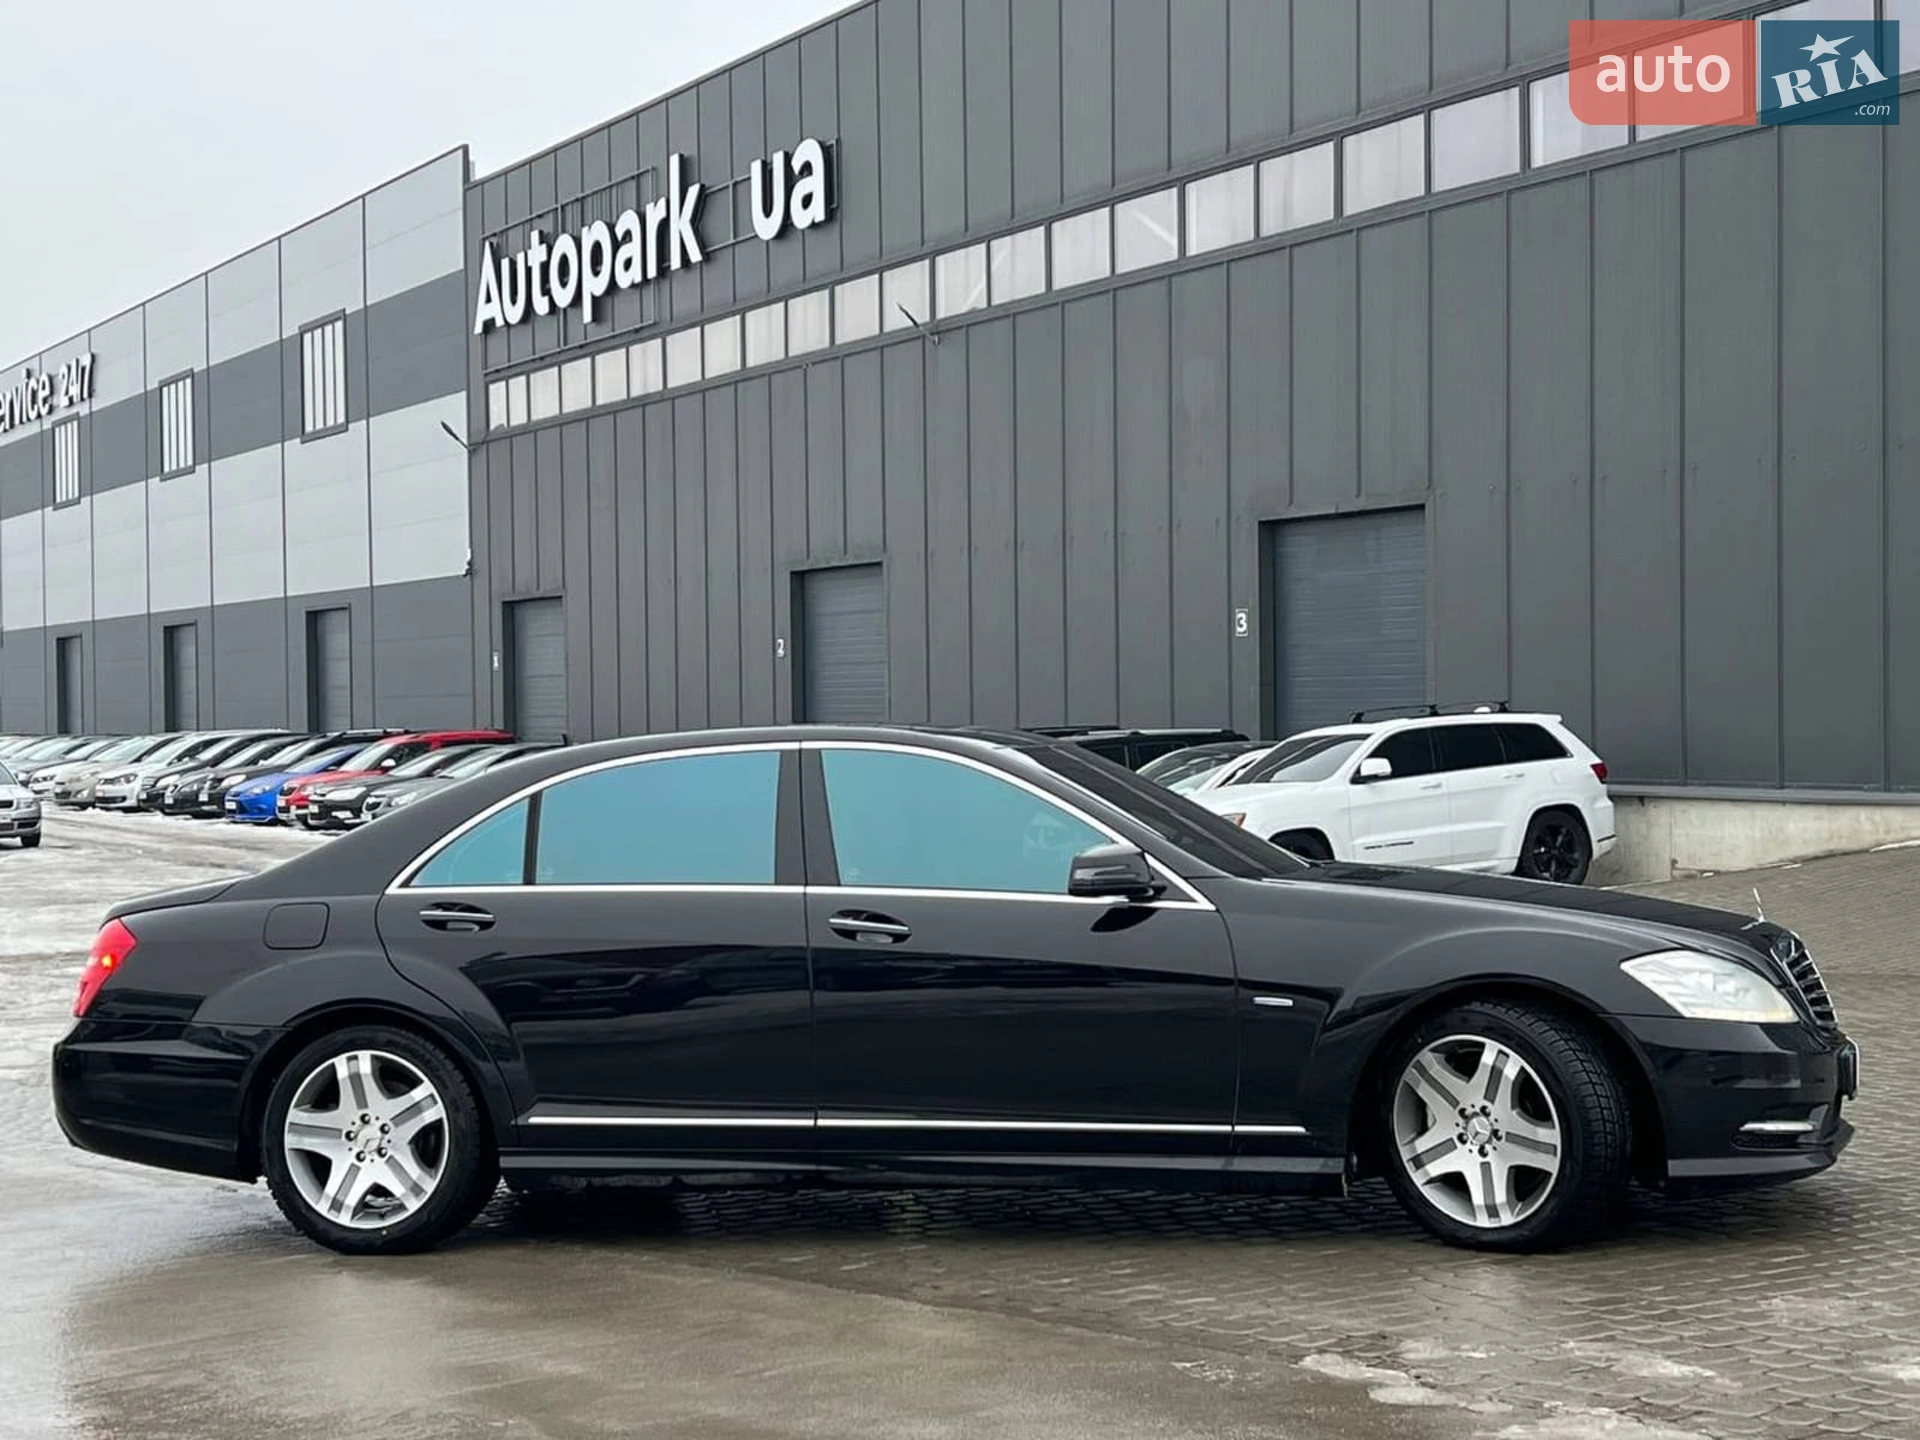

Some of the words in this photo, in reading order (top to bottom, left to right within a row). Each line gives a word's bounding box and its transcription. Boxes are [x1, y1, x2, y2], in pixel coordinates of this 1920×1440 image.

[473, 153, 703, 335] Autopark
[750, 138, 826, 241] ua
[1236, 611, 1248, 633] 3
